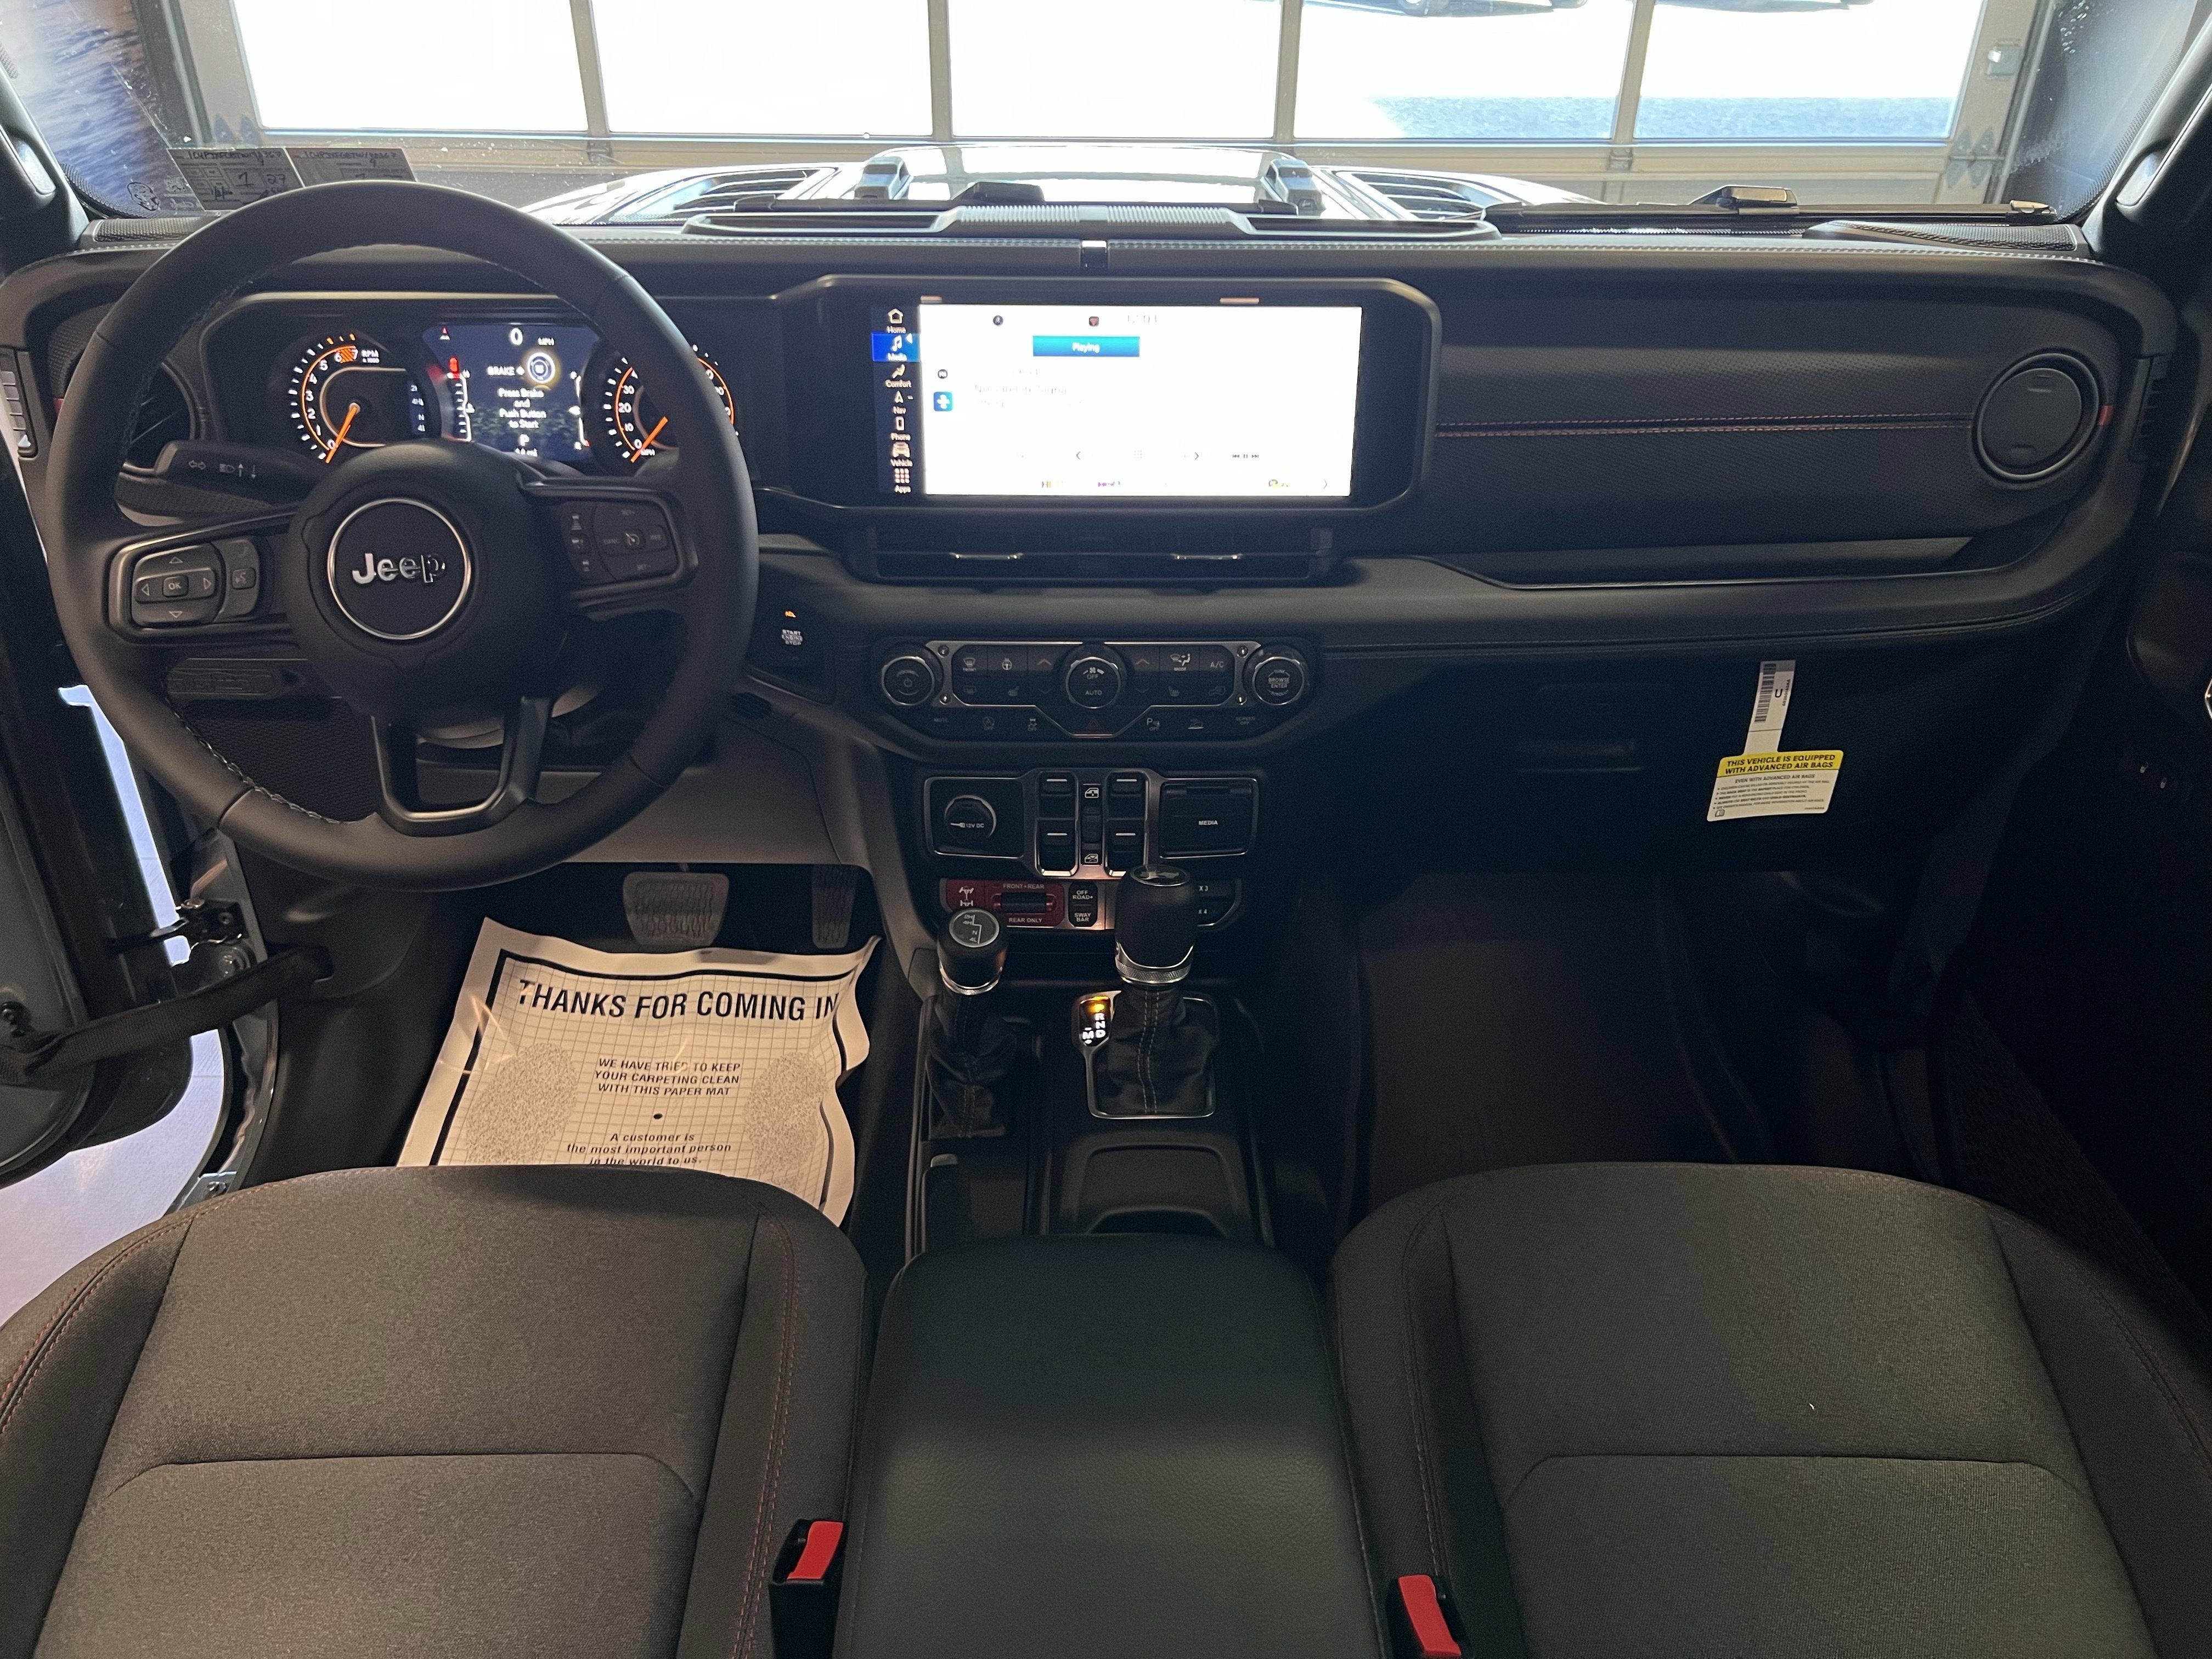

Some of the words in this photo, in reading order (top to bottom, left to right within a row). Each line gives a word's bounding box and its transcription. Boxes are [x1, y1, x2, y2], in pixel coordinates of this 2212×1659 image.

[510, 328, 523, 346] 0
[1071, 342, 1100, 353] Playing
[334, 352, 342, 363] 6
[360, 349, 379, 358] RPM
[887, 353, 907, 361] Media
[320, 360, 328, 371] 5
[487, 365, 516, 376] BRAKE
[623, 385, 635, 394] 30
[885, 380, 912, 388] Comfort
[306, 390, 314, 402] 3
[498, 387, 520, 398] Press
[618, 402, 631, 413] 20
[307, 408, 316, 419] 2
[499, 408, 520, 418] Push
[520, 409, 547, 419] Button
[624, 423, 634, 432] 10
[890, 432, 911, 441] Phone
[634, 438, 642, 449] 0
[890, 459, 913, 467] Vehicle
[894, 485, 911, 494] Apps
[352, 553, 446, 584] Jeep
[168, 583, 182, 591] OK
[1775, 689, 1783, 698] U
[1747, 756, 1780, 765] VEHICLE
[1725, 766, 1746, 775] WITH
[1747, 763, 1793, 772] ADVANCED
[519, 979, 627, 1018] THANKS
[634, 992, 688, 1019] FOR
[697, 991, 806, 1020] COMING
[815, 992, 839, 1019] IN
[1095, 1012, 1105, 1020] R
[1096, 1020, 1105, 1029] N
[1082, 1030, 1094, 1040] M
[1096, 1029, 1106, 1038] D
[599, 1058, 617, 1068] WE
[620, 1060, 652, 1070] HAVE
[655, 1061, 691, 1071] TRIED
[693, 1063, 708, 1072] TO
[711, 1063, 741, 1071] KEEP
[595, 1070, 627, 1081] YOUR
[631, 1073, 698, 1085] CARPETING
[702, 1075, 740, 1084] CLEAN
[599, 1083, 629, 1093] WITH
[634, 1085, 661, 1095] THIS
[664, 1087, 702, 1096] PAPER
[706, 1087, 731, 1096] MAT
[610, 1133, 619, 1142] A
[623, 1133, 681, 1142] customer
[685, 1132, 695, 1141] is
[567, 1143, 586, 1153] the
[590, 1143, 622, 1154] most
[625, 1143, 686, 1155] important
[689, 1142, 732, 1154] person
[604, 1156, 625, 1165] the
[629, 1156, 664, 1166] world
[667, 1156, 680, 1165] to
[683, 1155, 703, 1165] us.
